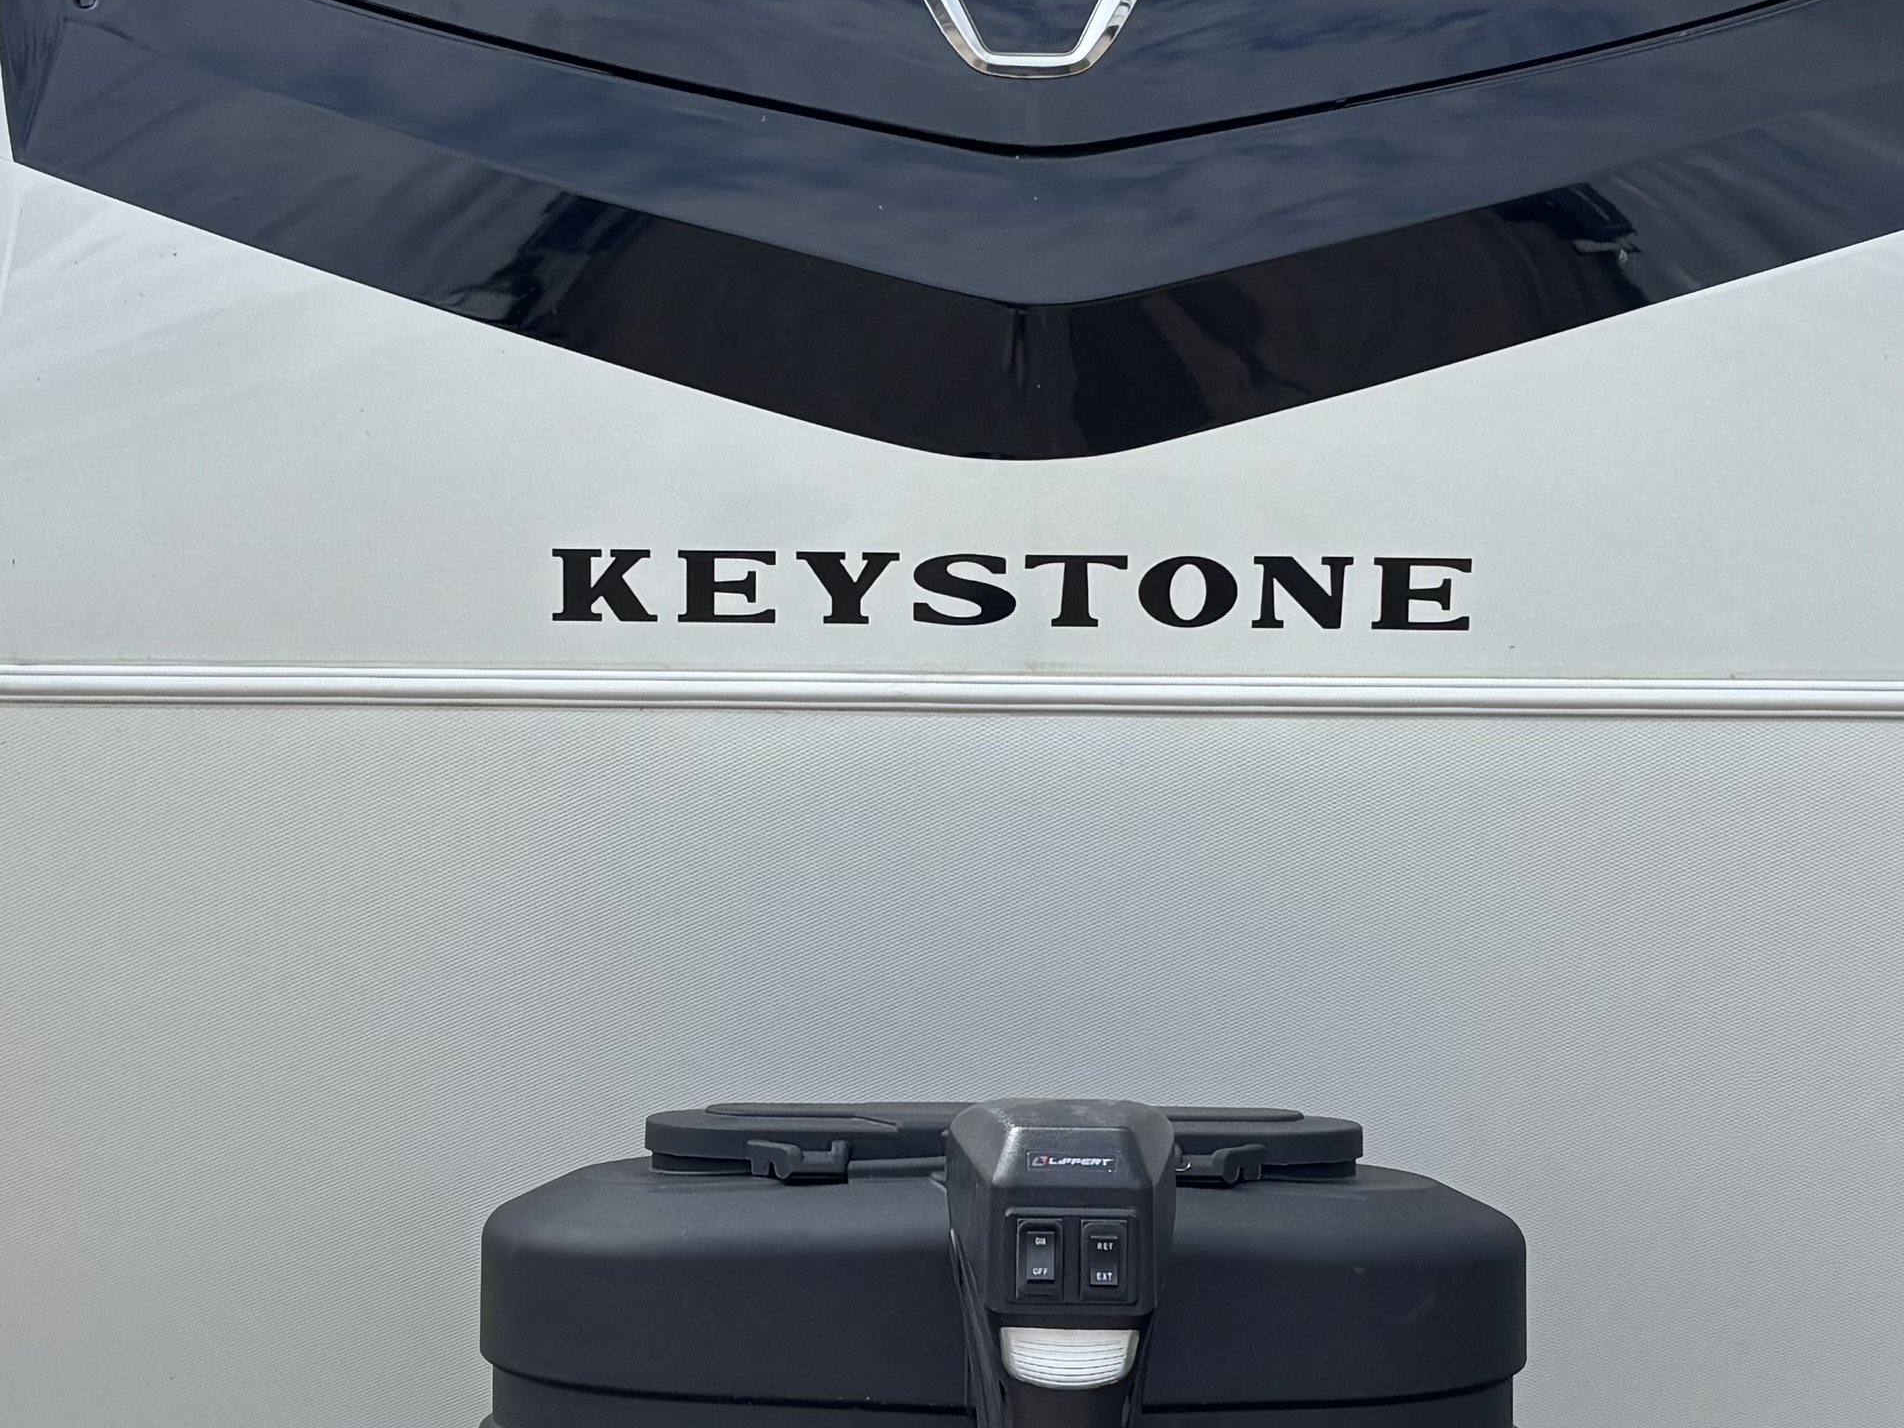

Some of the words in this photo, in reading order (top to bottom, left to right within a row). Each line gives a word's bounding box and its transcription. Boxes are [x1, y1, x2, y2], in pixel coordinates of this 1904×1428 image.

[551, 547, 1473, 631] KEYSTONE
[1032, 1267, 1048, 1276] OFF
[1096, 1272, 1112, 1281] EXT
